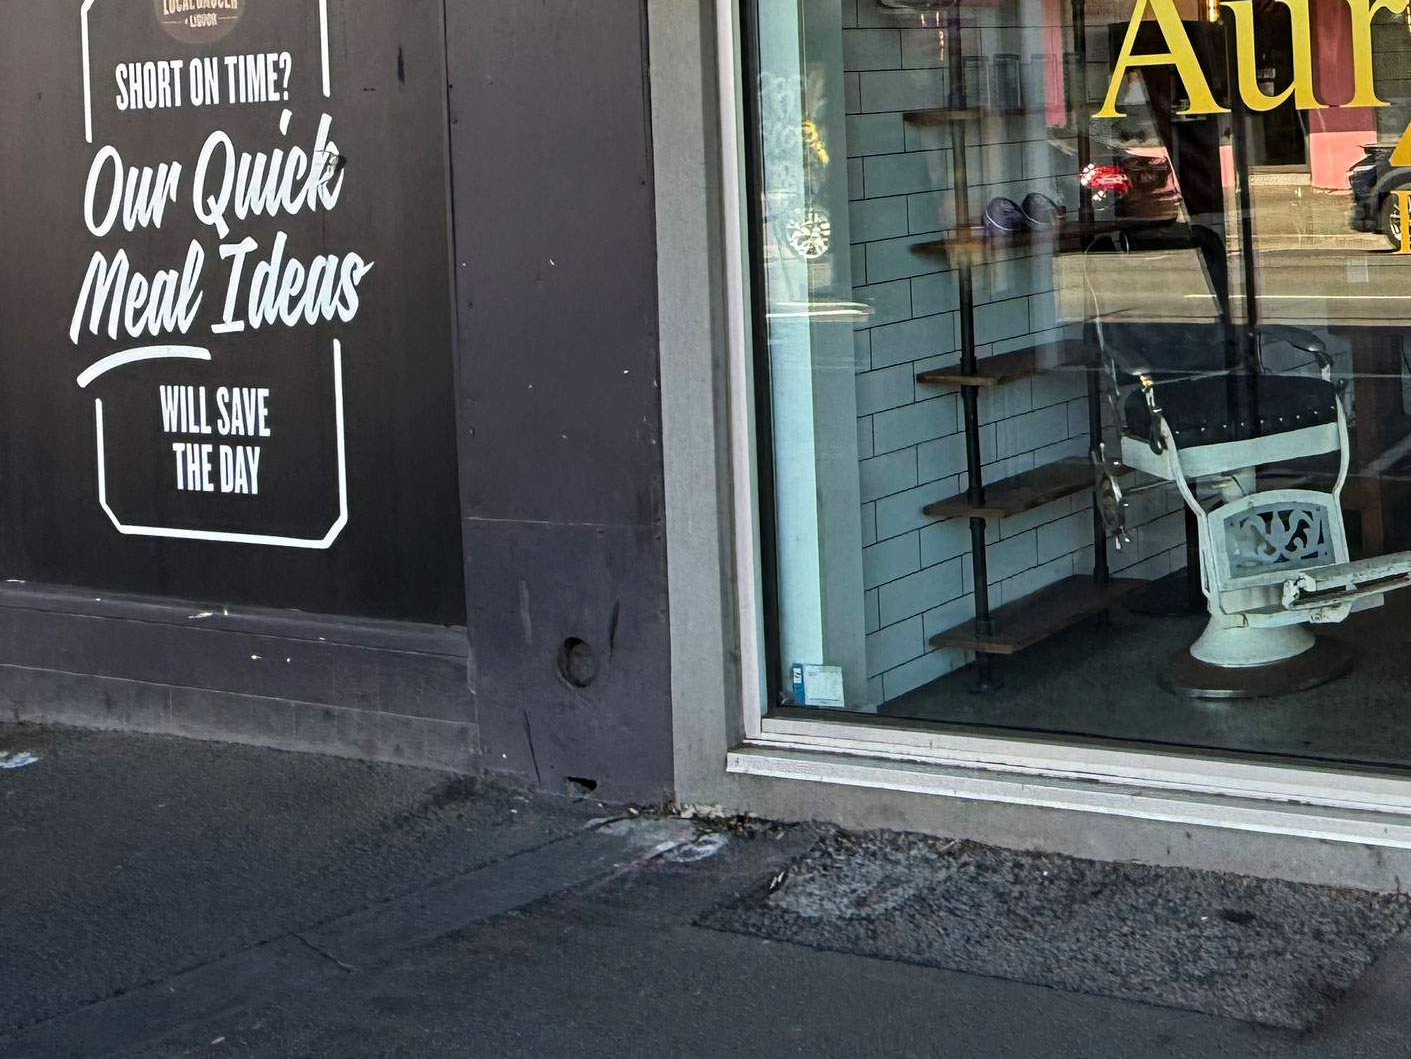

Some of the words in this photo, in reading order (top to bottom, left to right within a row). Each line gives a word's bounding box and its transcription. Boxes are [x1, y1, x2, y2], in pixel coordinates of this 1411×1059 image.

[115, 60, 183, 110] SHORT
[189, 57, 220, 107] ON
[224, 51, 292, 104] TIME?
[84, 145, 182, 237] Our
[192, 109, 345, 239] Quick
[69, 239, 205, 344] Meal
[211, 231, 375, 334] Ideas
[160, 385, 211, 435] WILL
[216, 386, 271, 437] SAVE
[172, 443, 215, 492] THE
[219, 445, 261, 495] DAY
